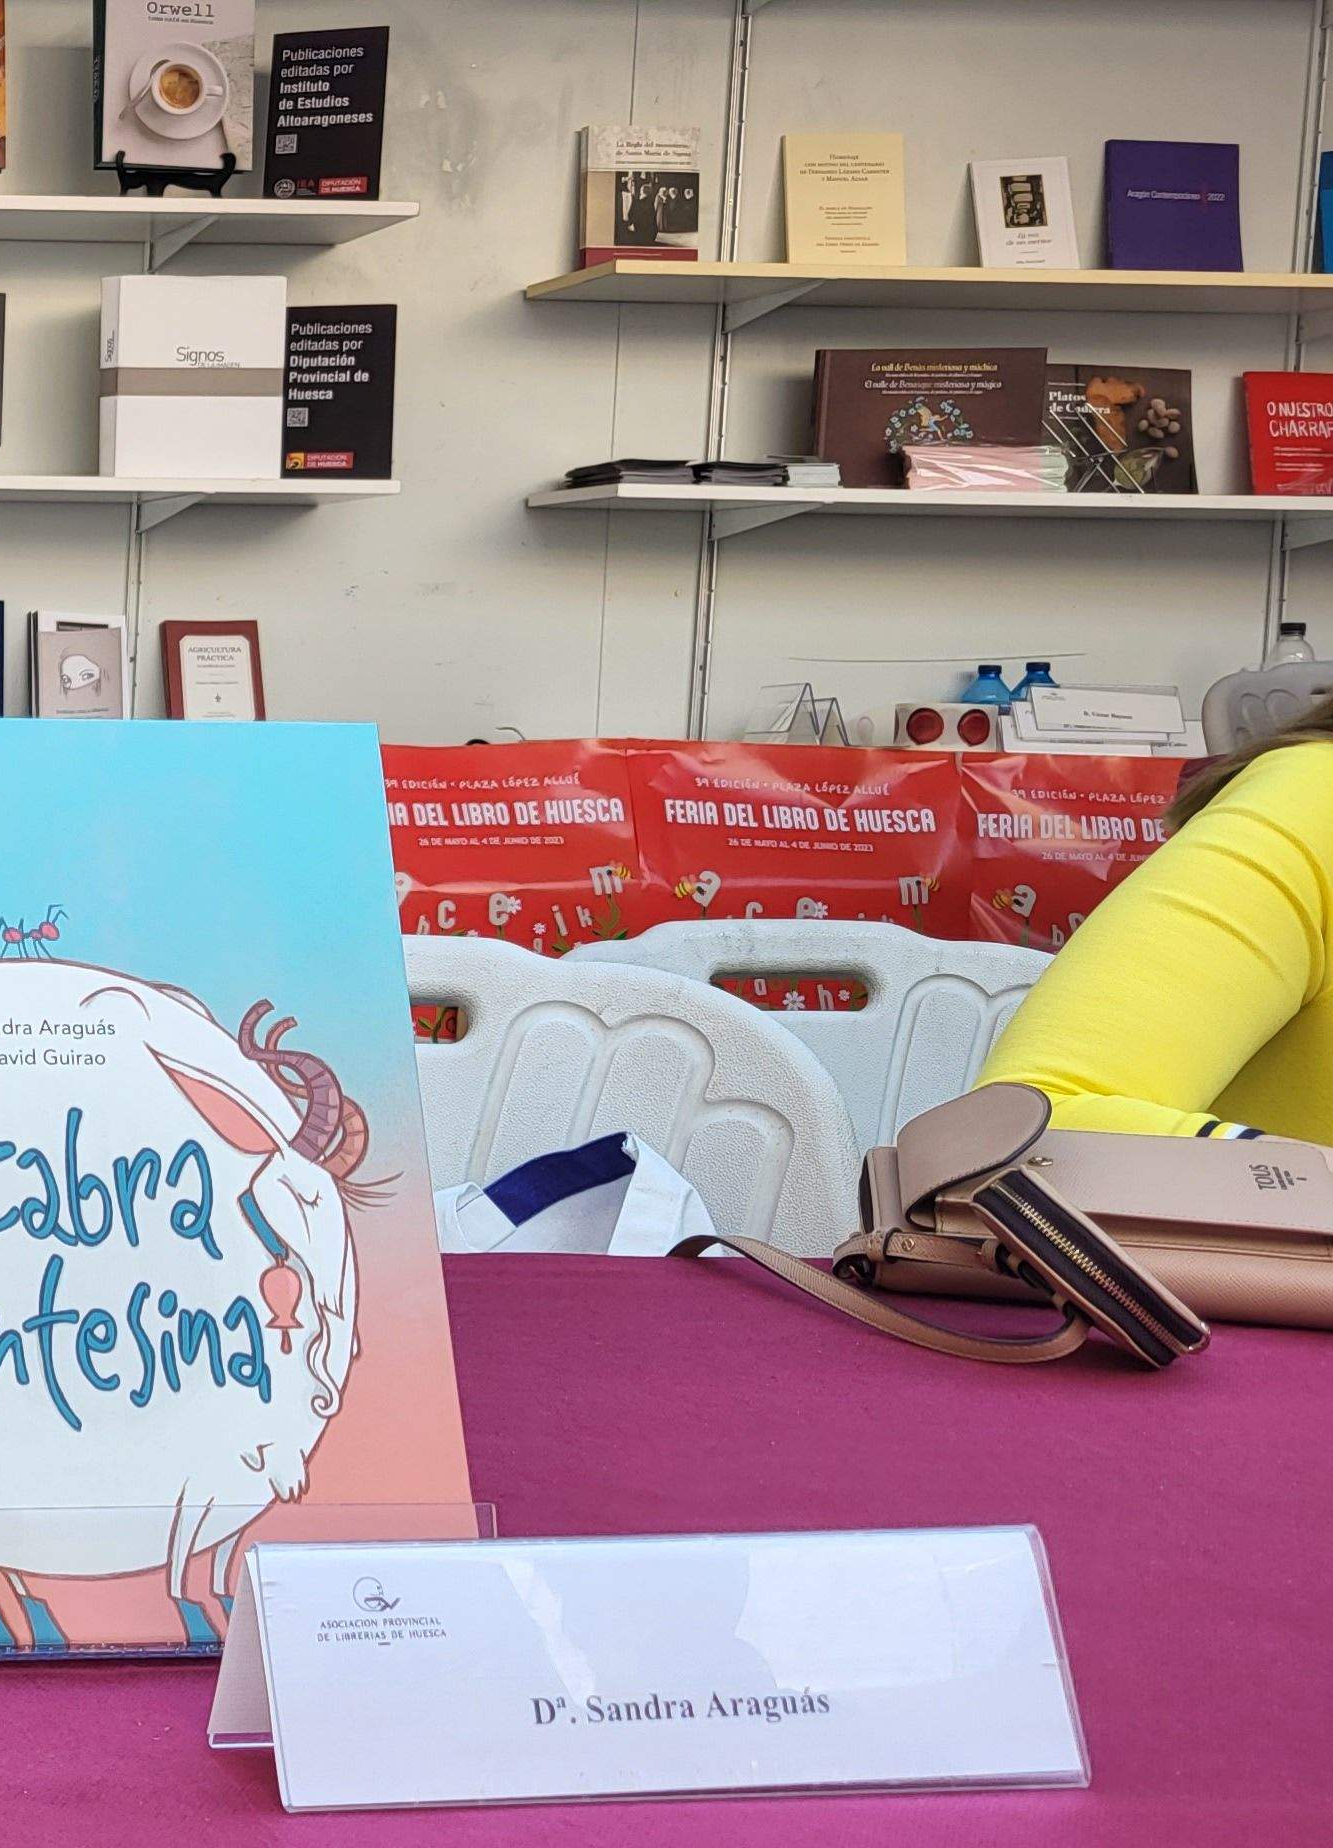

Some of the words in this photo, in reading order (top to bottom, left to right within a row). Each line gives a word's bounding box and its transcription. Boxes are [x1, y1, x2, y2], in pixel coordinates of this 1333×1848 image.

[146, 1, 215, 18] Orwell
[282, 46, 365, 62] Publicaciones
[280, 64, 330, 78] editadas
[333, 63, 355, 77] por
[279, 80, 330, 94] Instituto
[278, 98, 293, 110] de
[297, 96, 350, 109] Estudios
[277, 112, 374, 127] Altoaragoneses
[1127, 190, 1150, 199] Aragón
[1207, 193, 1226, 201] 2022
[291, 322, 373, 336] Publicaciones
[290, 339, 339, 351] editadas
[342, 340, 363, 352] por
[176, 346, 225, 366] Signos
[289, 354, 355, 369] Diputación
[289, 370, 350, 383] Provincial
[354, 370, 369, 382] de
[288, 388, 333, 400] Huesca
[1049, 391, 1087, 401] Platos
[1049, 402, 1064, 412] de
[1266, 401, 1276, 416] O
[1278, 401, 1333, 418] NUESTRO
[386, 779, 399, 789] 39
[401, 778, 447, 790] EDICIÓN
[459, 780, 498, 790] PLAZA
[502, 776, 539, 788] LÓPEZ
[543, 769, 581, 786] ALLUÉ
[694, 777, 710, 788] 39
[713, 777, 761, 791] EDICIÓN
[772, 781, 811, 793] PLAZA
[814, 780, 850, 795] LÓPEZ
[853, 781, 891, 797] ALLUÉ
[1011, 788, 1026, 799] 39
[1030, 788, 1077, 800] EDICIÓN
[1088, 792, 1127, 803] PLAZA
[1130, 792, 1167, 805] LÓPEZ
[412, 802, 449, 827] DEL
[451, 802, 510, 827] LIBRO
[513, 800, 542, 826] DE
[543, 797, 625, 825] HUESCA
[664, 798, 719, 826] FERIA
[722, 802, 759, 828] DEL
[762, 804, 820, 831] LIBRO
[823, 808, 851, 832] DE
[853, 807, 937, 834] HUESCA
[977, 813, 1033, 840] FERIA
[1039, 814, 1077, 840] DEL
[1081, 814, 1137, 842] LIBRO
[1140, 818, 1167, 842] DE
[418, 837, 429, 846] 26
[431, 837, 443, 846] DE
[444, 837, 468, 845] MAYO
[469, 837, 480, 845] AL
[481, 837, 488, 845] 4
[489, 837, 501, 845] DE
[503, 837, 529, 845] JUNIO
[530, 836, 541, 844] DE
[728, 837, 739, 847] 26
[740, 838, 753, 848] DE
[754, 839, 777, 848] MAYO
[779, 840, 790, 849] AL
[790, 840, 798, 849] 4
[799, 840, 811, 849] DE
[812, 841, 839, 851] JUNIO
[840, 842, 852, 851] DE
[853, 843, 874, 852] 2023
[1041, 851, 1054, 861] 26
[1055, 852, 1068, 861] DE
[1069, 852, 1094, 861] MAYO
[1095, 852, 1106, 861] AL
[1106, 852, 1114, 861] 4
[1115, 853, 1128, 862] DE
[39, 1018, 116, 1040] Araguás
[43, 1048, 106, 1066] Guirao
[1248, 1164, 1277, 1190] TOUS
[383, 1616, 442, 1627] PROVINCIAL
[317, 1632, 330, 1642] DE
[335, 1631, 387, 1642] LIBRERIAS
[390, 1630, 404, 1639] DE
[408, 1628, 447, 1639] HUESCA
[532, 1695, 577, 1725] Dª.
[585, 1692, 695, 1724] Sandra
[706, 1686, 831, 1724] Araguás
